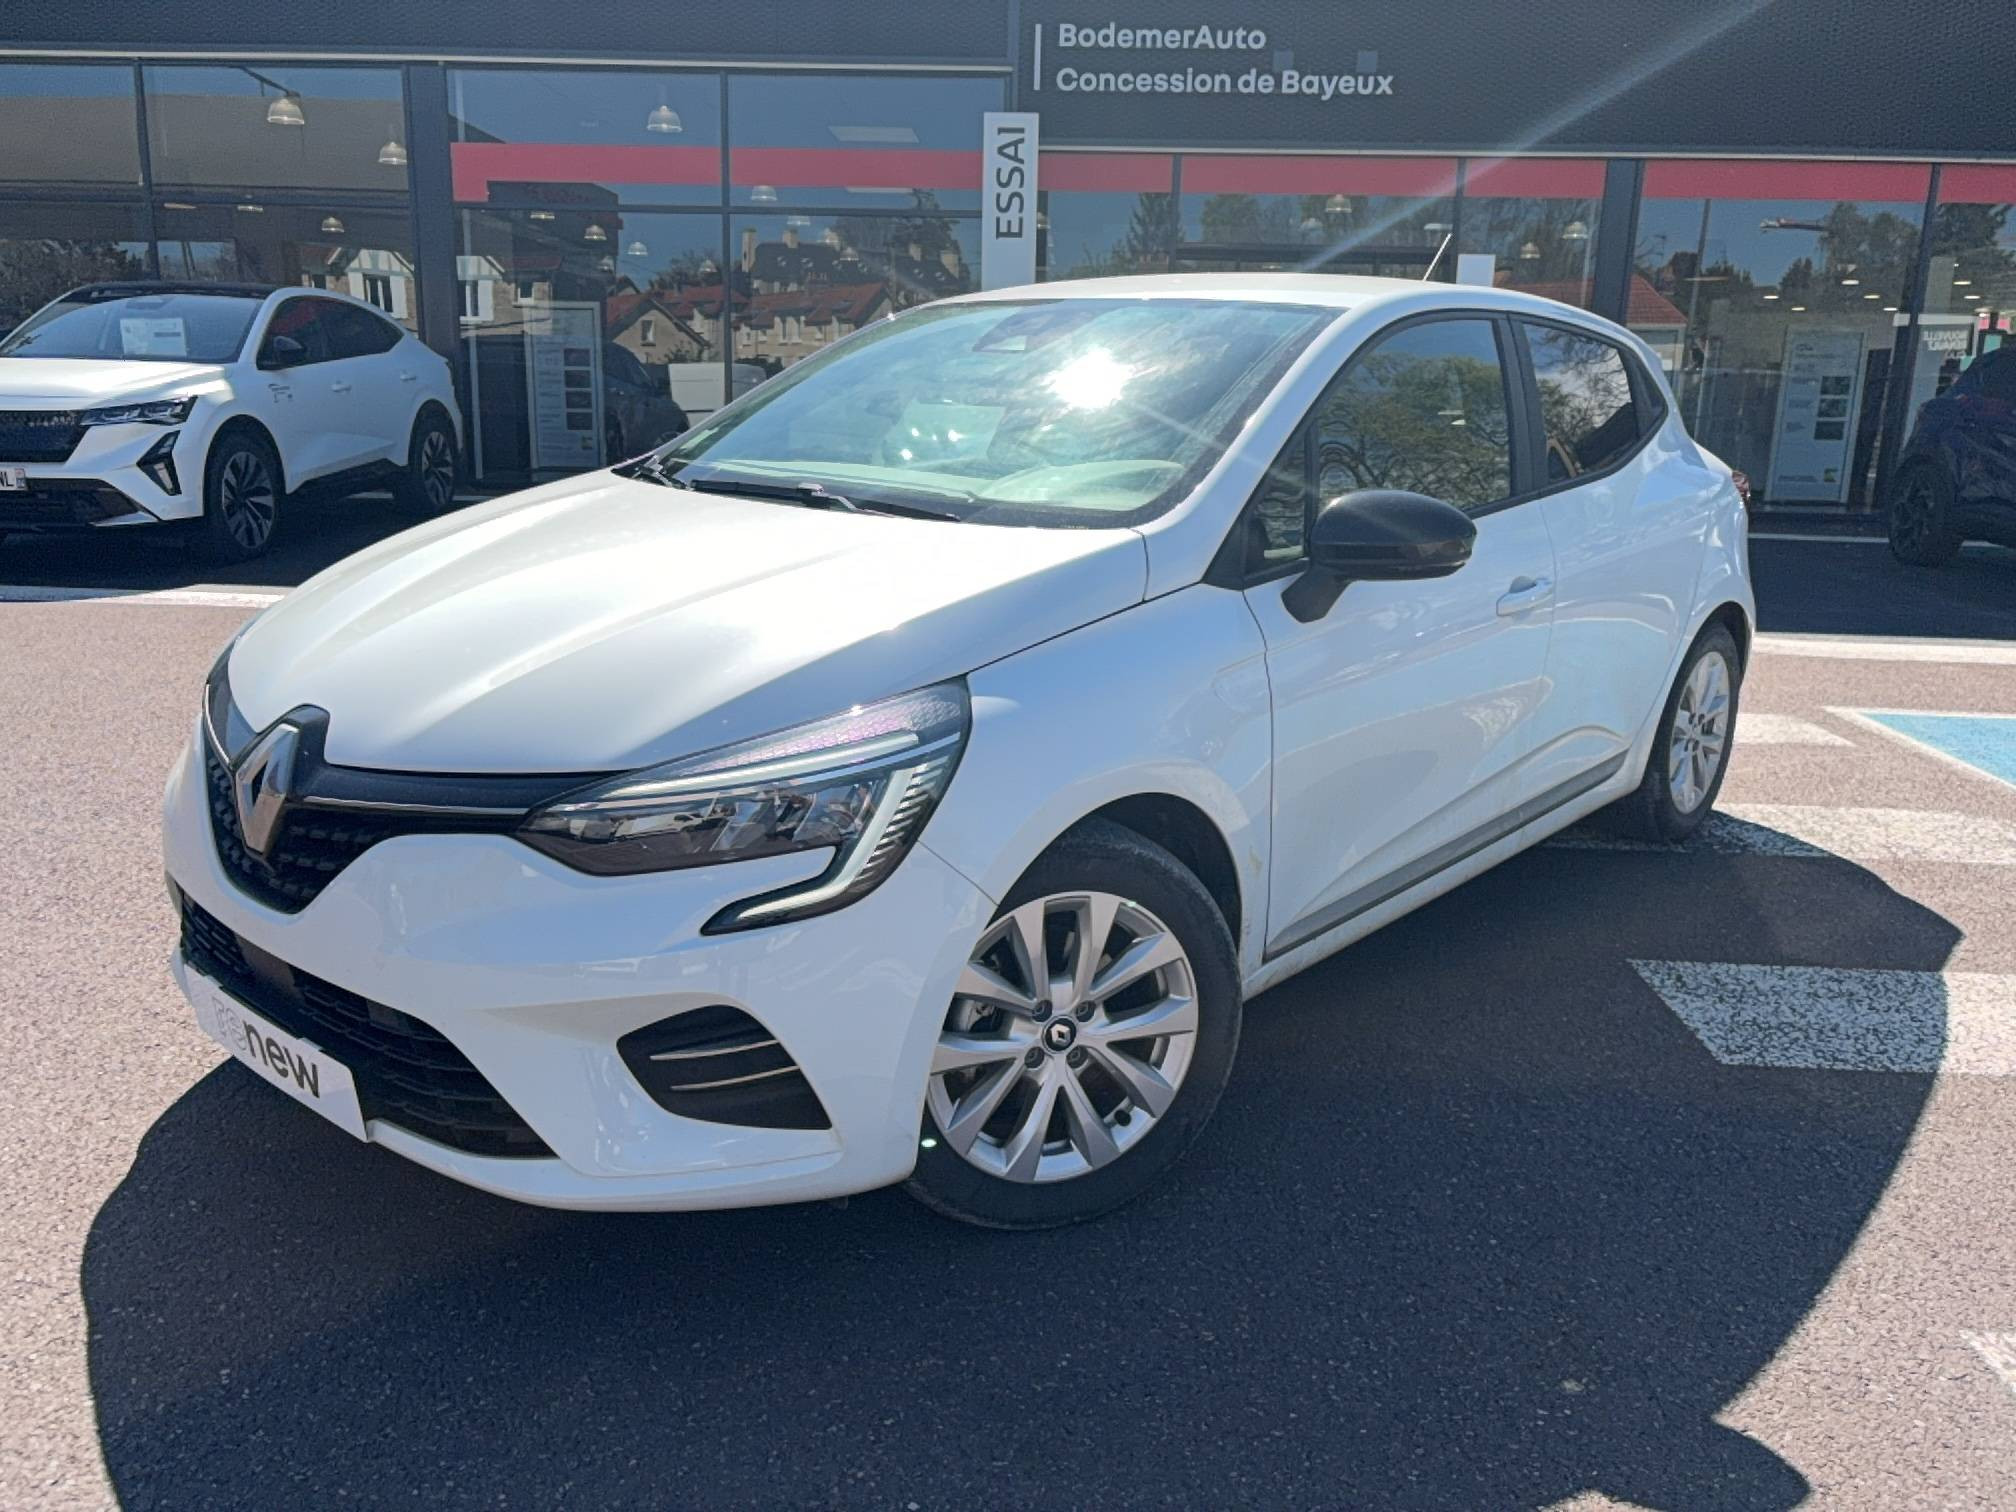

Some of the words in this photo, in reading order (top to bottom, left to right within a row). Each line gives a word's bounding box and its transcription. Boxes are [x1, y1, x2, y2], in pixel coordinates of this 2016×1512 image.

[1058, 22, 1267, 50] BodemerAuto
[1056, 67, 1231, 94] Concession
[1237, 68, 1275, 94] de
[1281, 70, 1394, 100] Bayeux
[996, 127, 1025, 240] ESSAI
[211, 996, 320, 1099] renew
